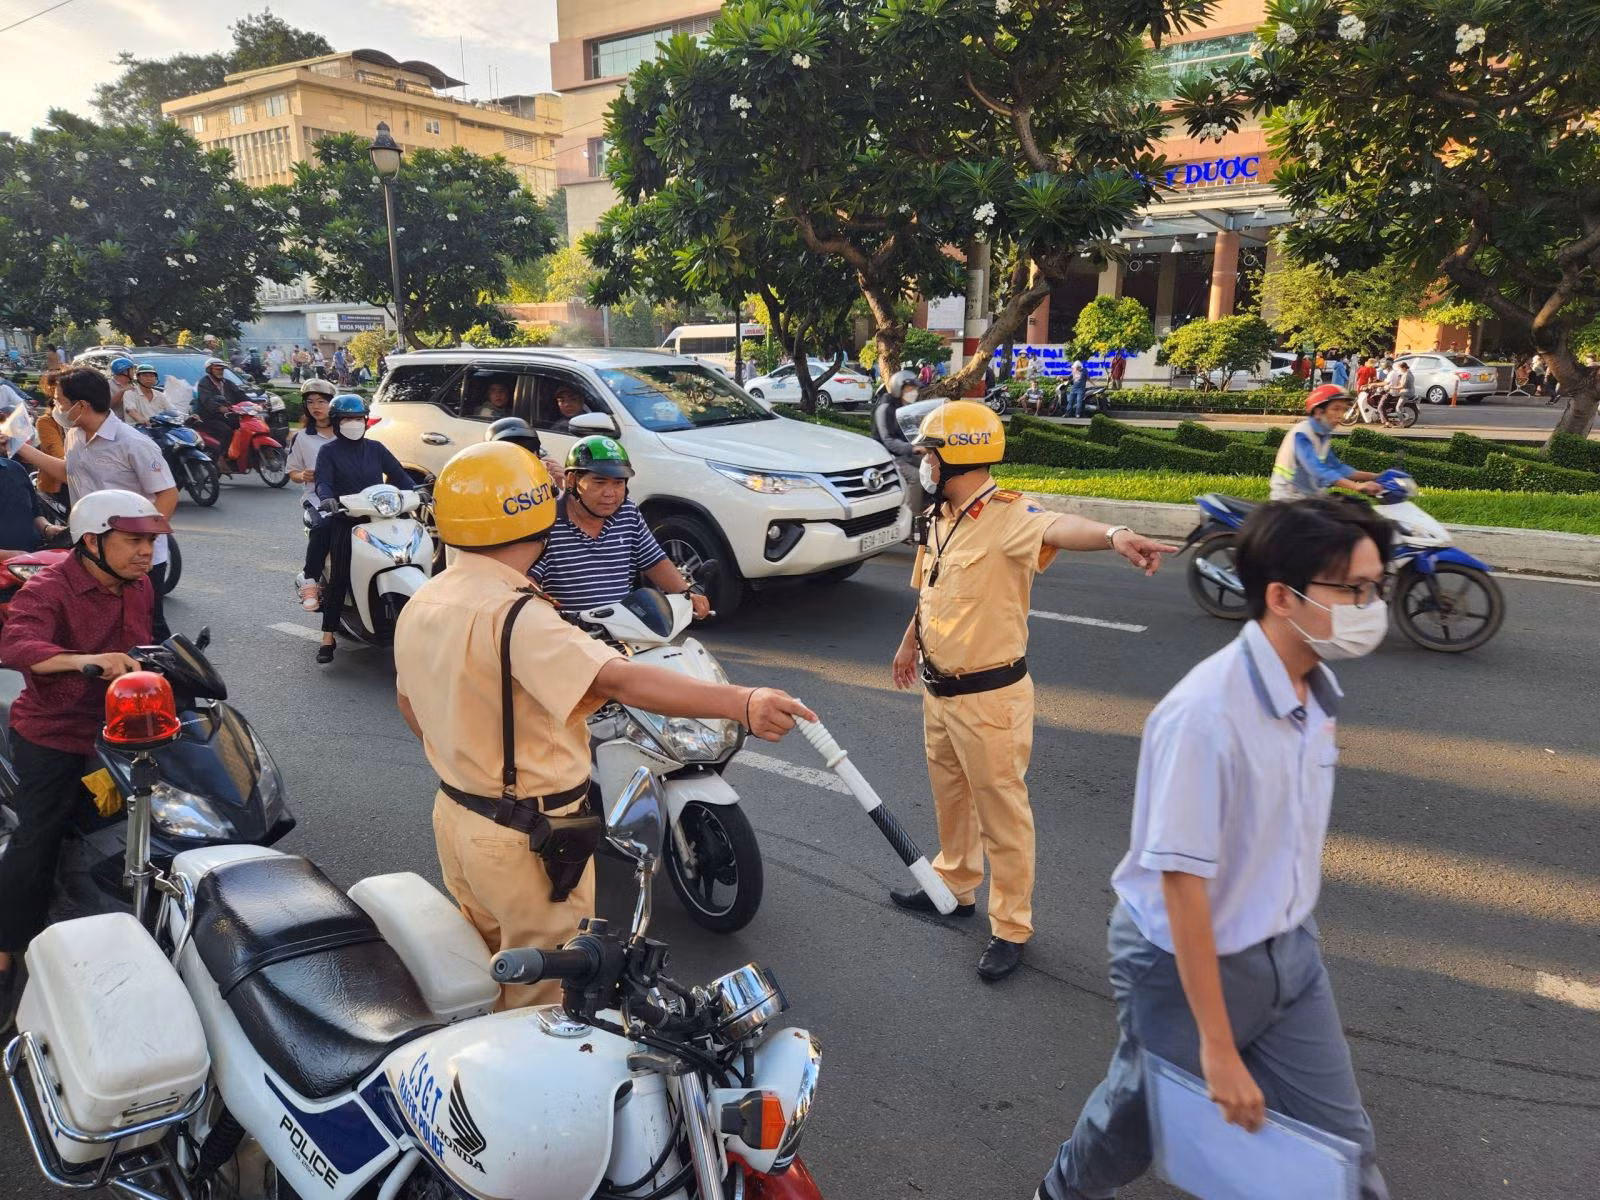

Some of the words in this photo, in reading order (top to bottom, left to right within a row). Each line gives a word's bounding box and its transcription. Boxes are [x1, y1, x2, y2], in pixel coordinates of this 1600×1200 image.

[1184, 156, 1260, 185] DƯỢC
[947, 432, 992, 446] CSGT
[502, 483, 551, 516] CSGT
[397, 1069, 418, 1125] TRAFFIC
[418, 1111, 446, 1164] POLICE
[279, 1113, 339, 1190] POLICE
[436, 1124, 487, 1175] HONDA
